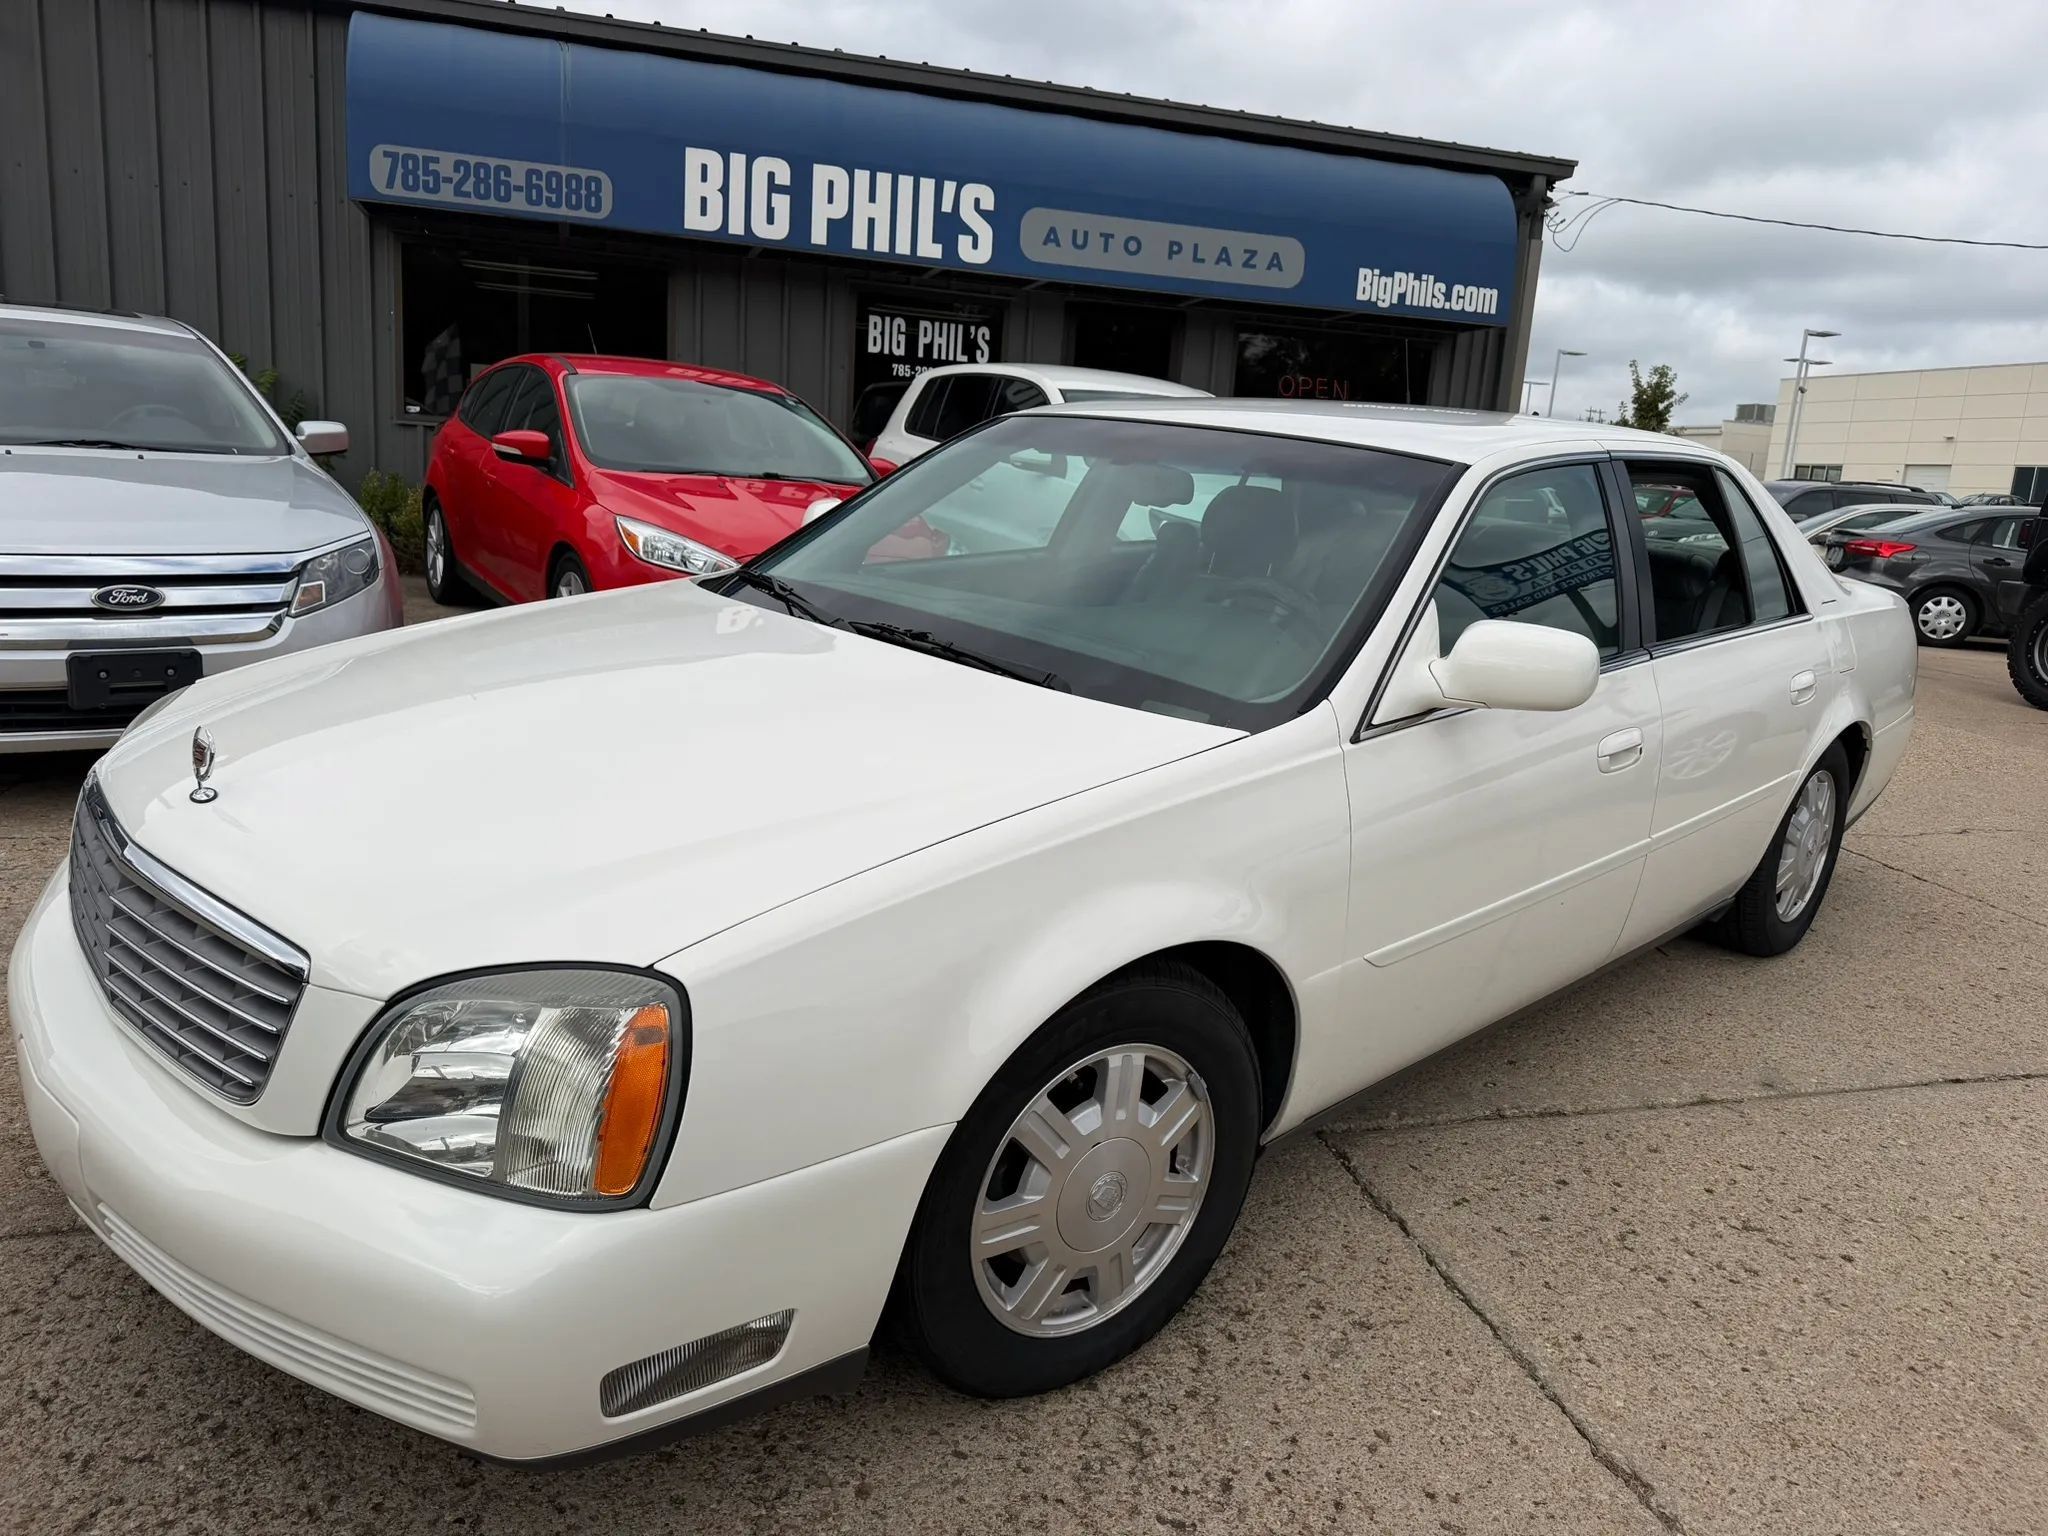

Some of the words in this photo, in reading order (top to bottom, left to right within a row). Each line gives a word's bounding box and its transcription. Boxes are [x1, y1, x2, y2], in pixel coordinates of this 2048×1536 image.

[383, 150, 602, 213] 785-286-6988
[684, 147, 791, 240] BIG
[811, 163, 995, 264] PHIL'S
[1042, 226, 1143, 256] AUTO
[1167, 240, 1284, 272] PLAZA
[1356, 267, 1498, 315] BigPhils.com
[867, 314, 906, 356] BIG
[917, 320, 991, 364] PHIL'S
[1279, 375, 1348, 400] OPEN
[109, 589, 148, 604] Ford
